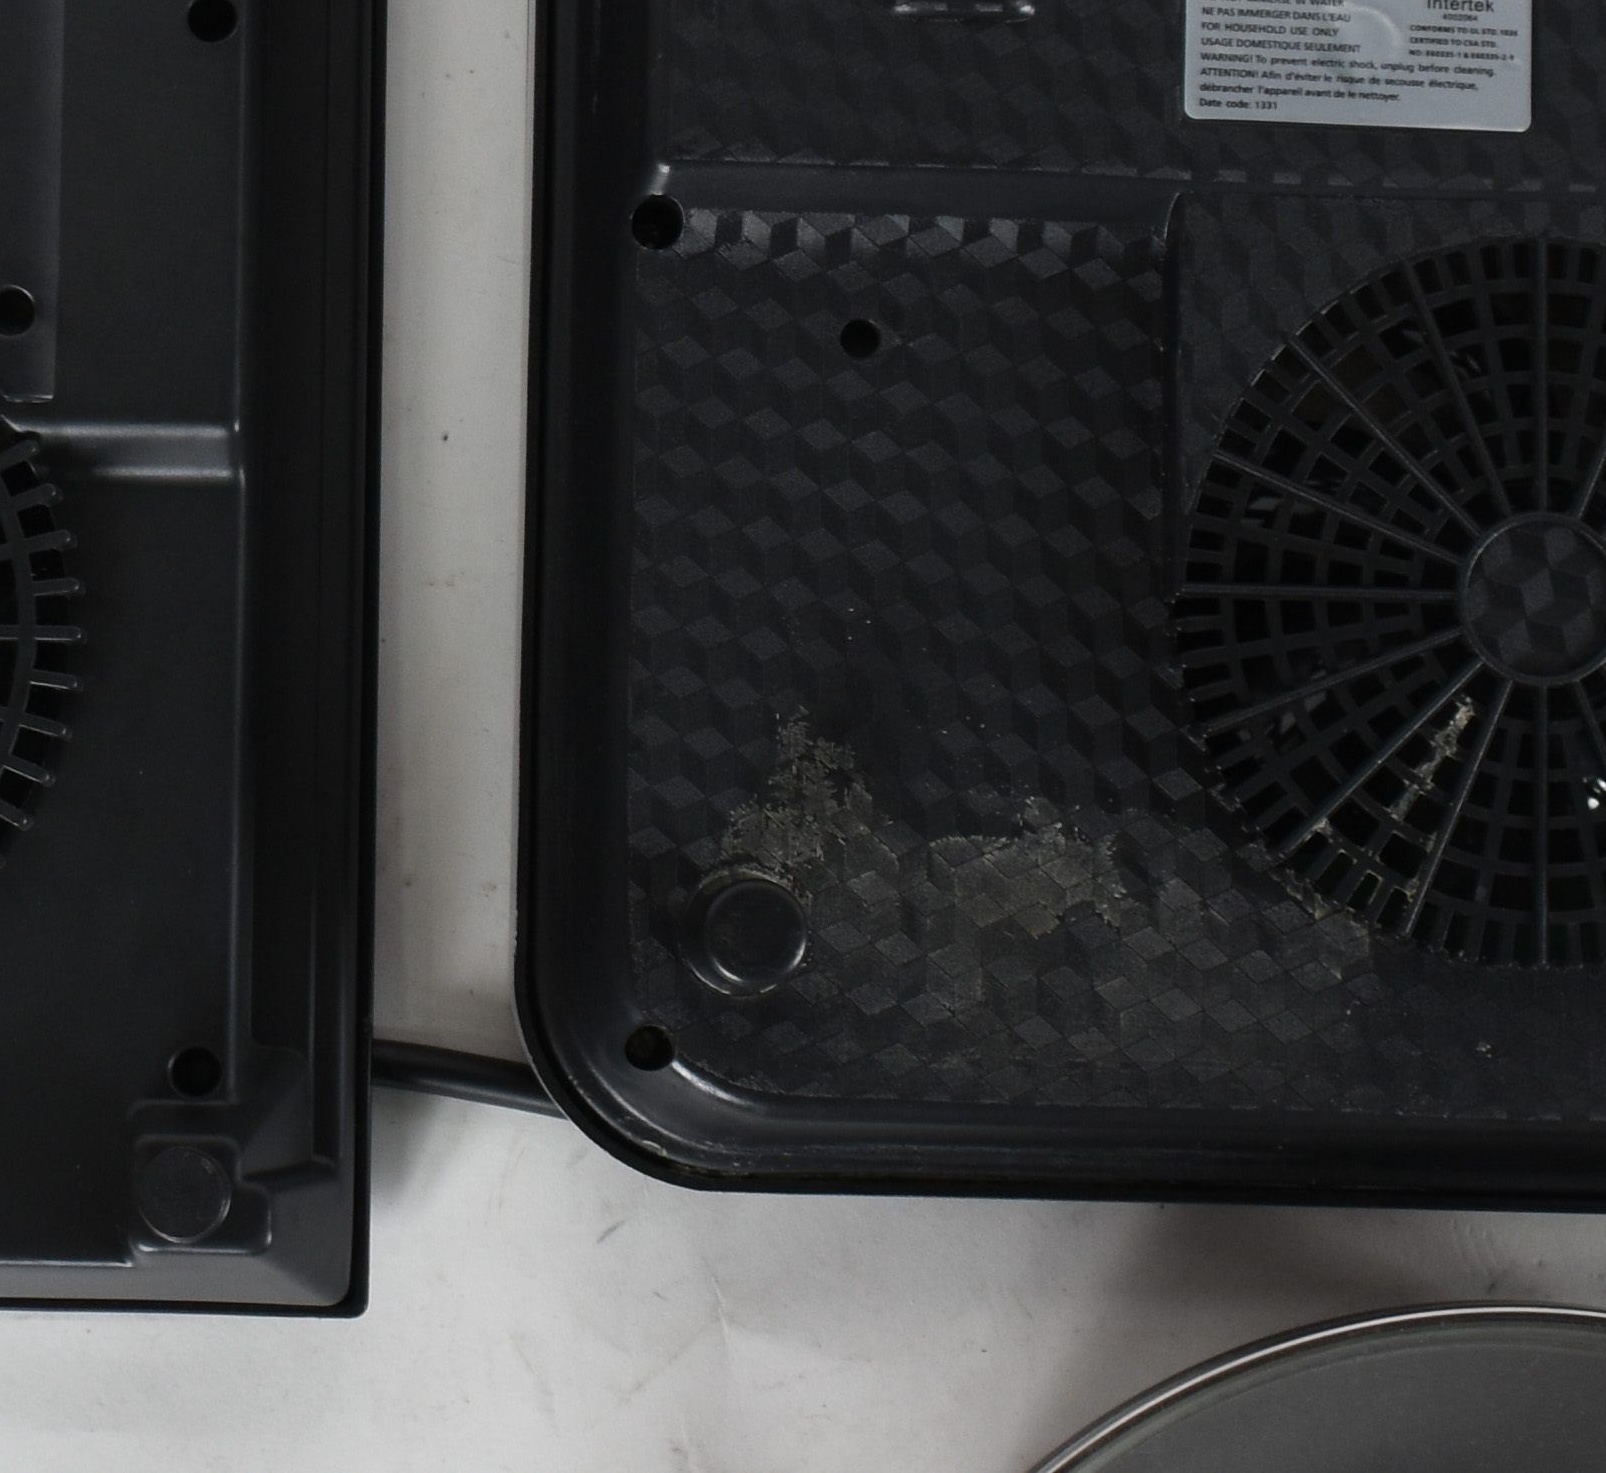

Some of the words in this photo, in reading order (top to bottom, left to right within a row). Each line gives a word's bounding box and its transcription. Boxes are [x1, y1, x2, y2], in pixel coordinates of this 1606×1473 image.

[1201, 6, 1215, 16] NE
[1216, 7, 1236, 17] PAS
[1236, 8, 1292, 20] IMMERGER
[1292, 11, 1322, 22] DANS
[1321, 12, 1352, 23] L'EAU
[1201, 22, 1221, 32] FOR
[1224, 23, 1286, 34] HOUSEHOLD
[1290, 25, 1308, 35] USE
[1312, 26, 1339, 37] ONLY
[1457, 26, 1468, 34] TO
[1200, 36, 1234, 47] USAGE
[1236, 38, 1302, 52] DOMESTIQUE
[1304, 41, 1361, 53] SEULEMENT
[1451, 38, 1462, 46] TO
[1199, 52, 1253, 63] WARNING!
[1254, 54, 1268, 64] To
[1270, 55, 1308, 68] prevent
[1310, 57, 1345, 68] electric
[1348, 59, 1379, 72] shock,
[1380, 61, 1415, 73] unplug
[1417, 63, 1451, 74] before
[1200, 67, 1259, 79] ATTENTION!
[1261, 70, 1282, 80] Afin
[1324, 73, 1332, 83] le
[1337, 74, 1365, 86] risque
[1369, 76, 1381, 86] de
[1384, 77, 1425, 88] secousse
[1304, 88, 1332, 98] avant
[1333, 89, 1346, 99] de
[1347, 90, 1357, 100] le
[1199, 97, 1223, 107] Date
[1255, 100, 1278, 110] 1331
